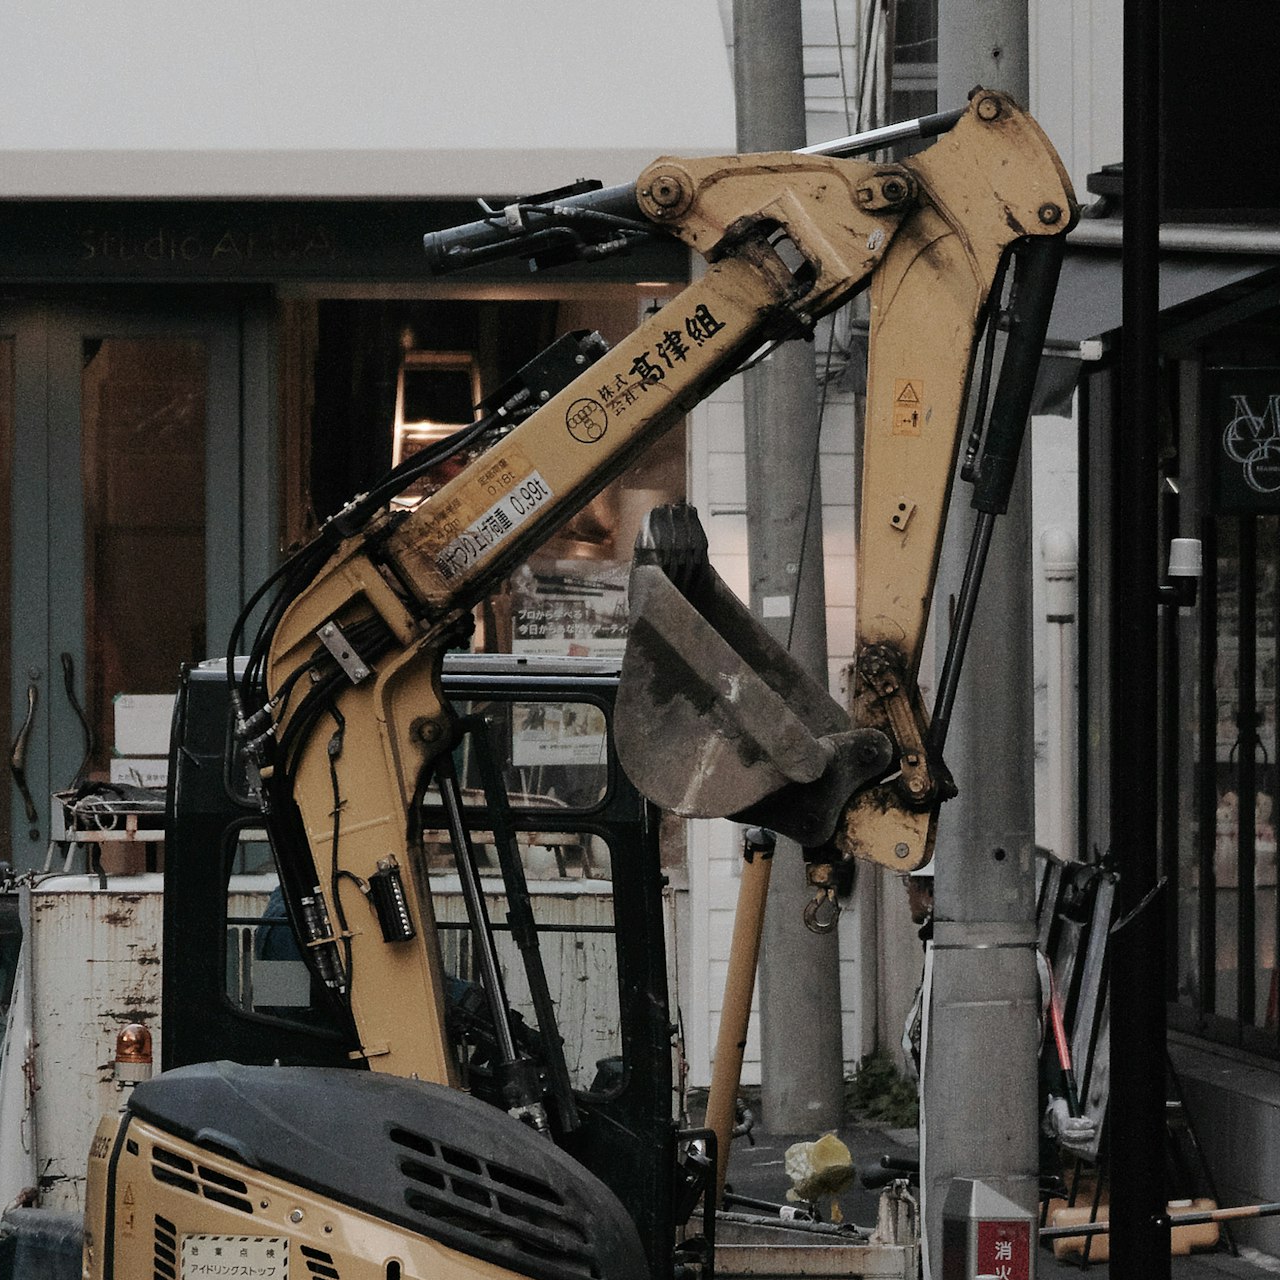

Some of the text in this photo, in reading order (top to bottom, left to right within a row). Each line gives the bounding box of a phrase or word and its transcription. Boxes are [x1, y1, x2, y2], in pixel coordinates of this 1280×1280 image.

[509, 478, 549, 516] 0.99t
[190, 1264, 276, 1277] アイドリングストップ
